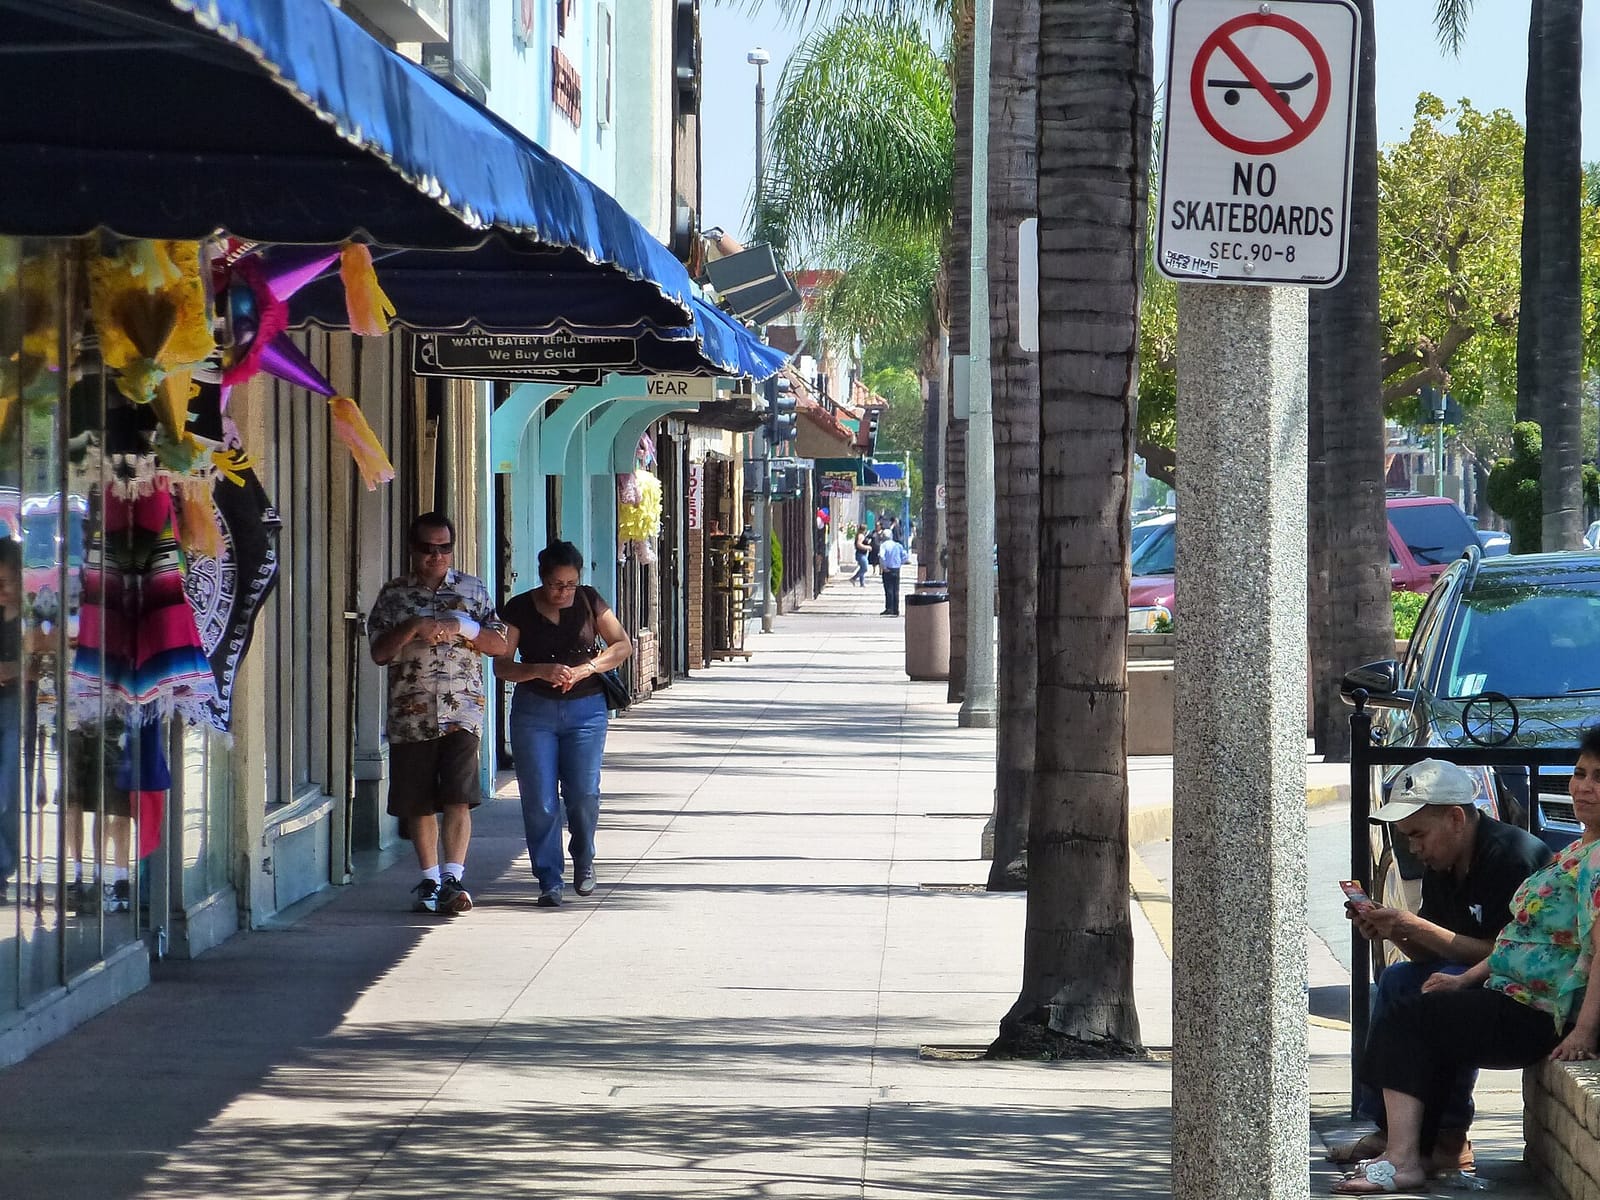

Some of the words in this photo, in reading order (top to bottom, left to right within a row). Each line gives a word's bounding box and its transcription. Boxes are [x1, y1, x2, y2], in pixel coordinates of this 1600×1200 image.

[1232, 162, 1277, 198] NO
[1171, 200, 1334, 237] SKATEBOARDS
[1209, 242, 1296, 263] SEC.90-8
[451, 338, 493, 347] WATCH
[497, 337, 540, 346] BATERY
[488, 350, 510, 360] We
[515, 349, 539, 361] Buy
[543, 347, 576, 359] Gold
